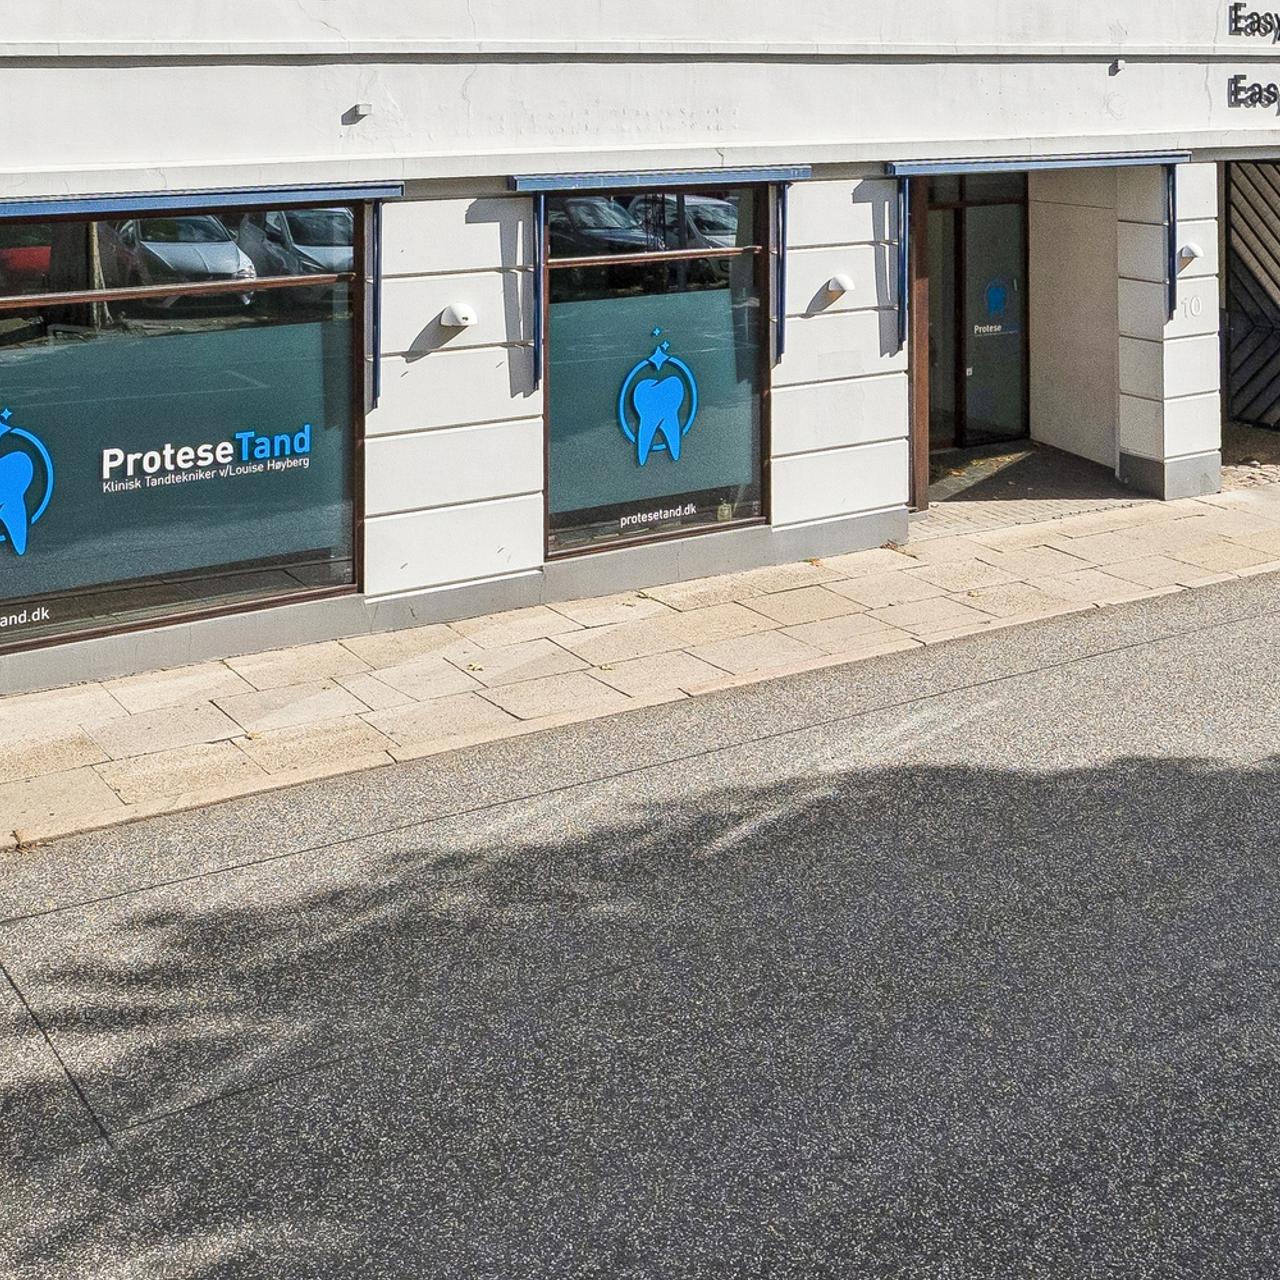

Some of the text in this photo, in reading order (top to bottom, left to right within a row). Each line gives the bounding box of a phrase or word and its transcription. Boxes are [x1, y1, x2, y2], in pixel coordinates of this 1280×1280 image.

[1180, 296, 1201, 319] 10
[102, 424, 311, 479] ProteseTand
[103, 457, 310, 493] Klinisk Tandtekniker v/Louise Høyberg
[620, 503, 697, 529] protesetand.dk
